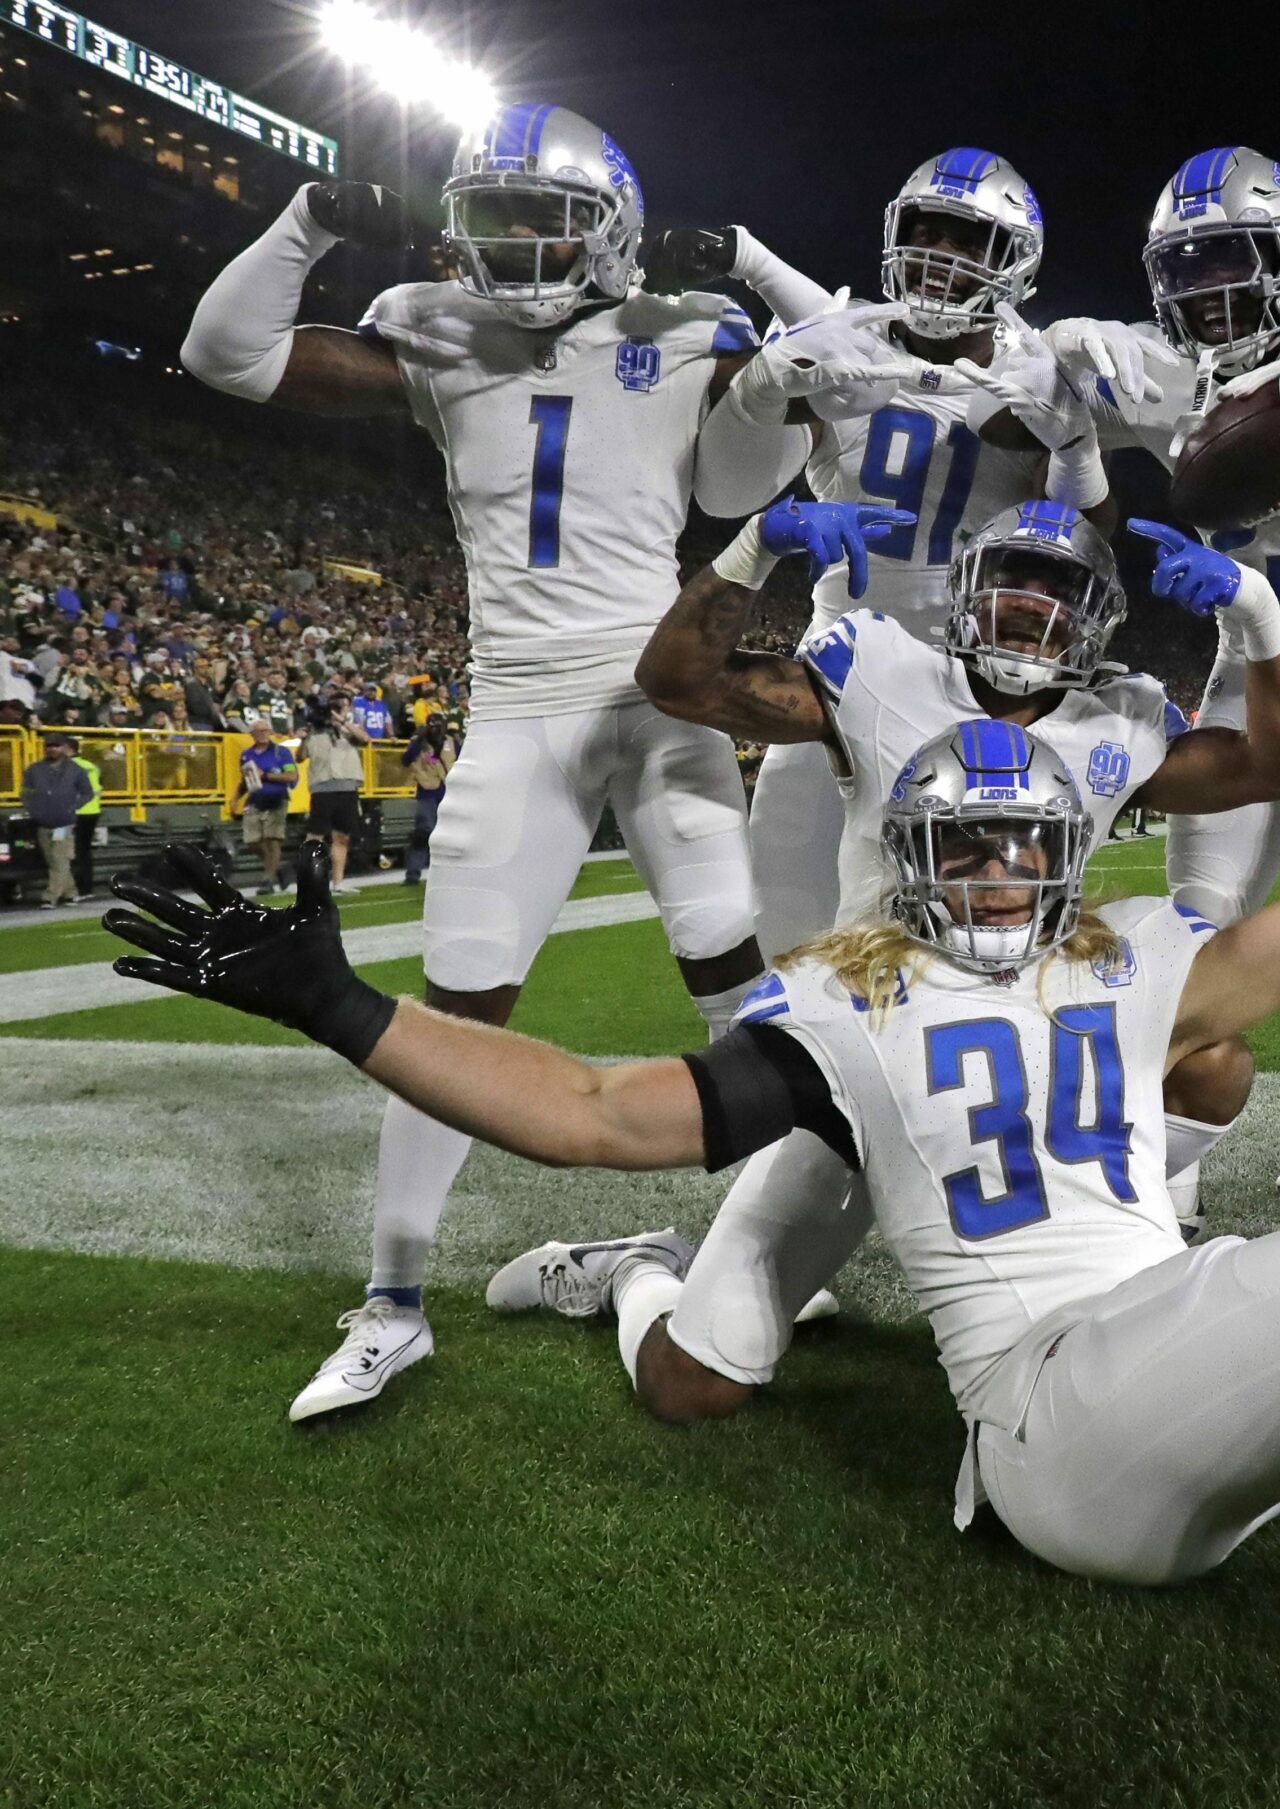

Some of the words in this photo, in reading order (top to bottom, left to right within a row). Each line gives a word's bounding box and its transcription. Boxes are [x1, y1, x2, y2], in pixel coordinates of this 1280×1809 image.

[1192, 377, 1209, 411] NXTRND
[528, 395, 573, 568] 1
[859, 404, 981, 566] 91
[979, 788, 1018, 800] LIONS
[1092, 748, 1129, 783] 90
[923, 1001, 1140, 1242] 34
